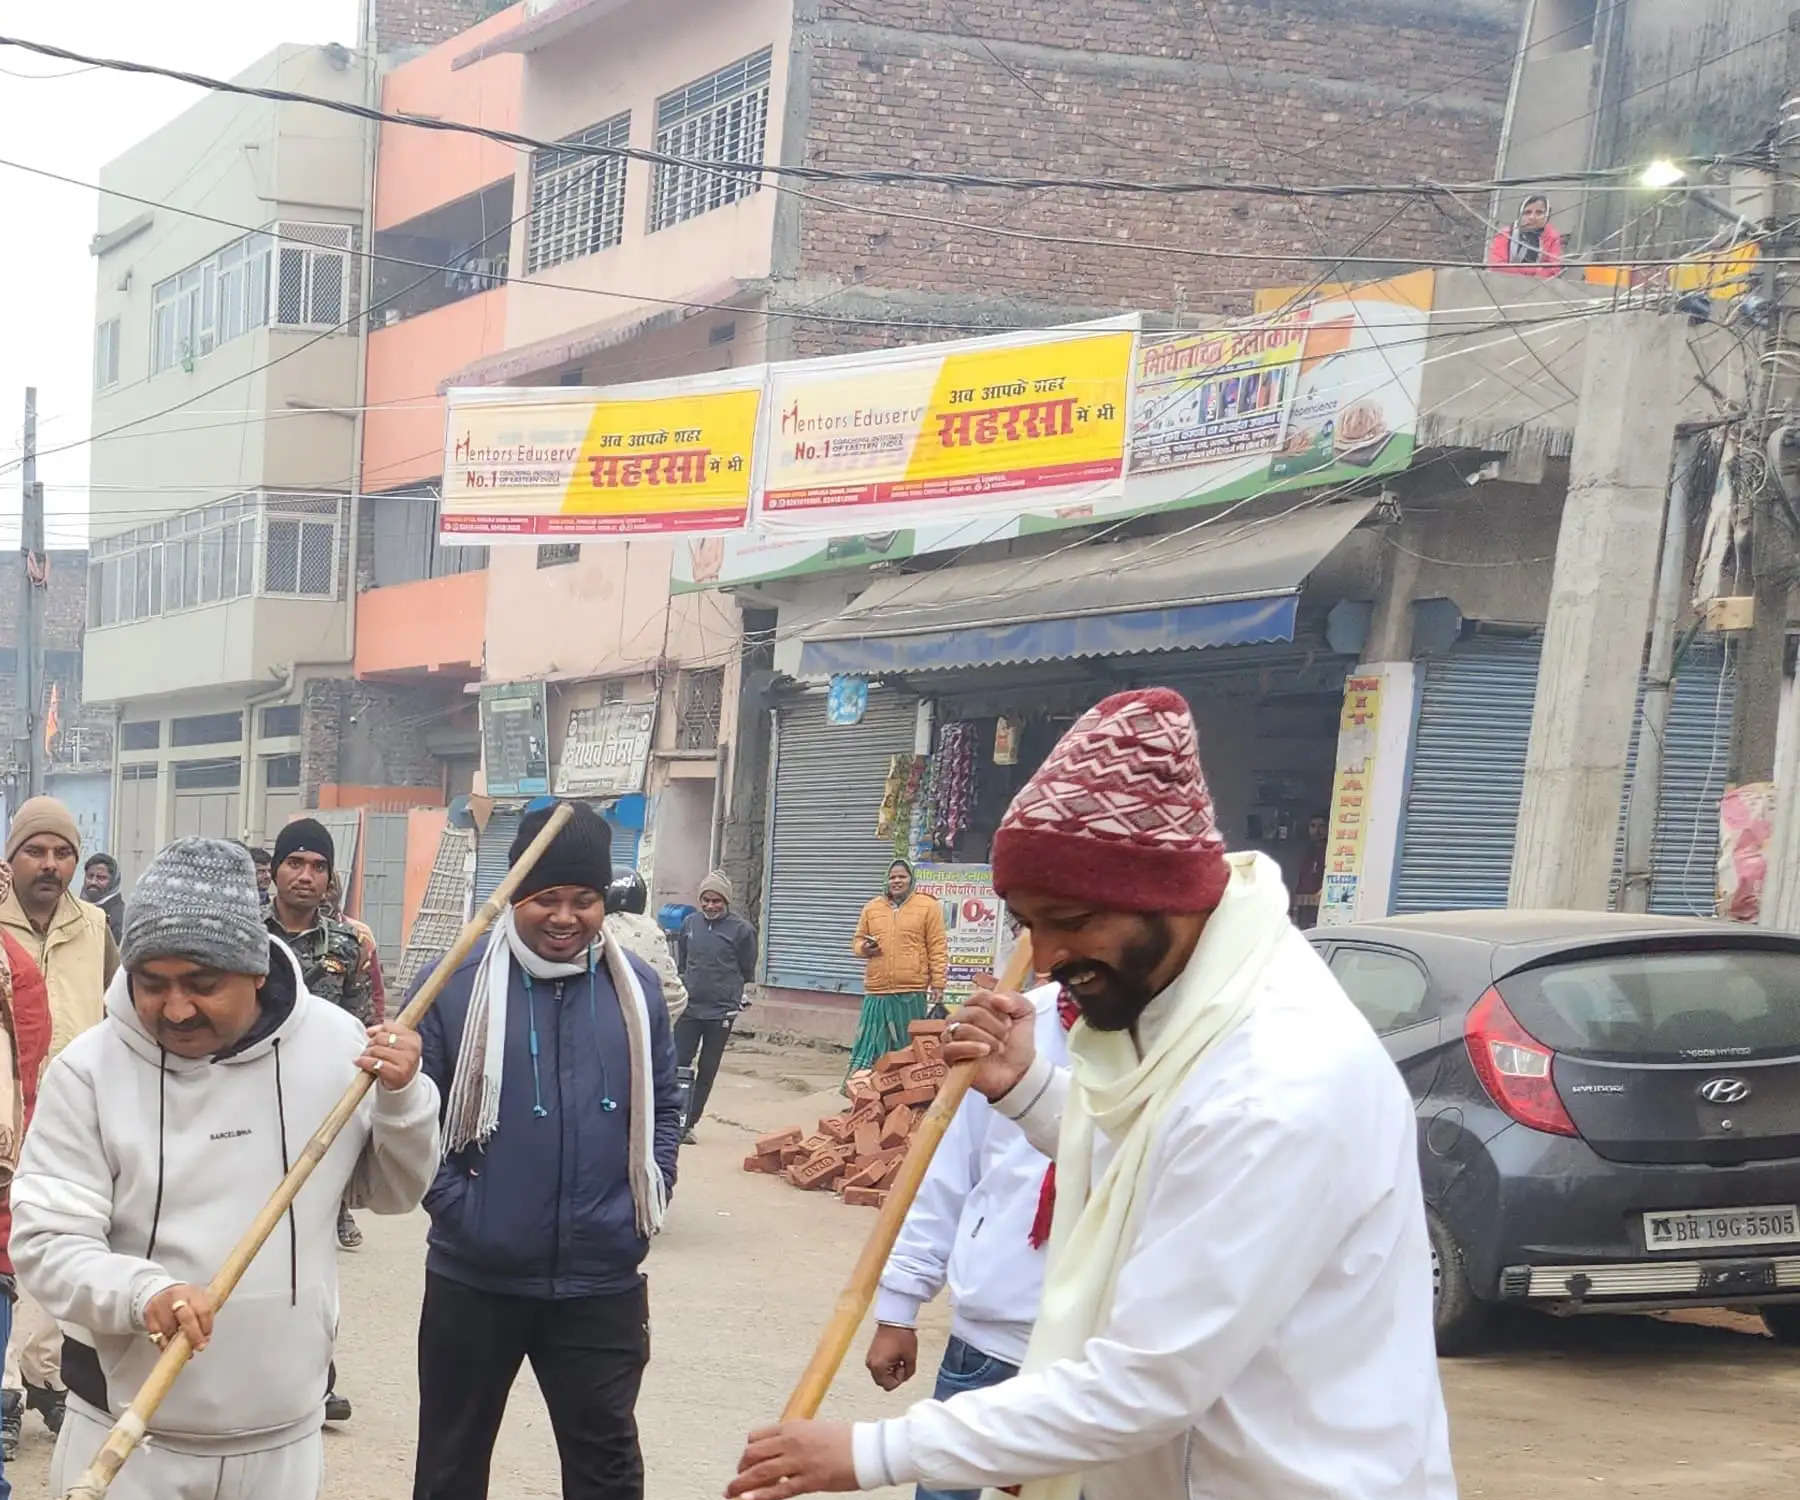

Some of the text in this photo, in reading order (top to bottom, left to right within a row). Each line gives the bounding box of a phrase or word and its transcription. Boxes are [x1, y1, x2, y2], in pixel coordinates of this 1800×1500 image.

[949, 377, 1066, 404] अब आपके शहर
[854, 406, 922, 427] Eduserv
[935, 398, 1116, 449] सहरसा में भी
[600, 429, 703, 447] अब आपके शहर
[517, 446, 577, 463] Eduserv
[588, 449, 744, 488] सहरसा में भी
[963, 898, 996, 922] 0%
[1676, 1215, 1795, 1242] BR 19G 5505
